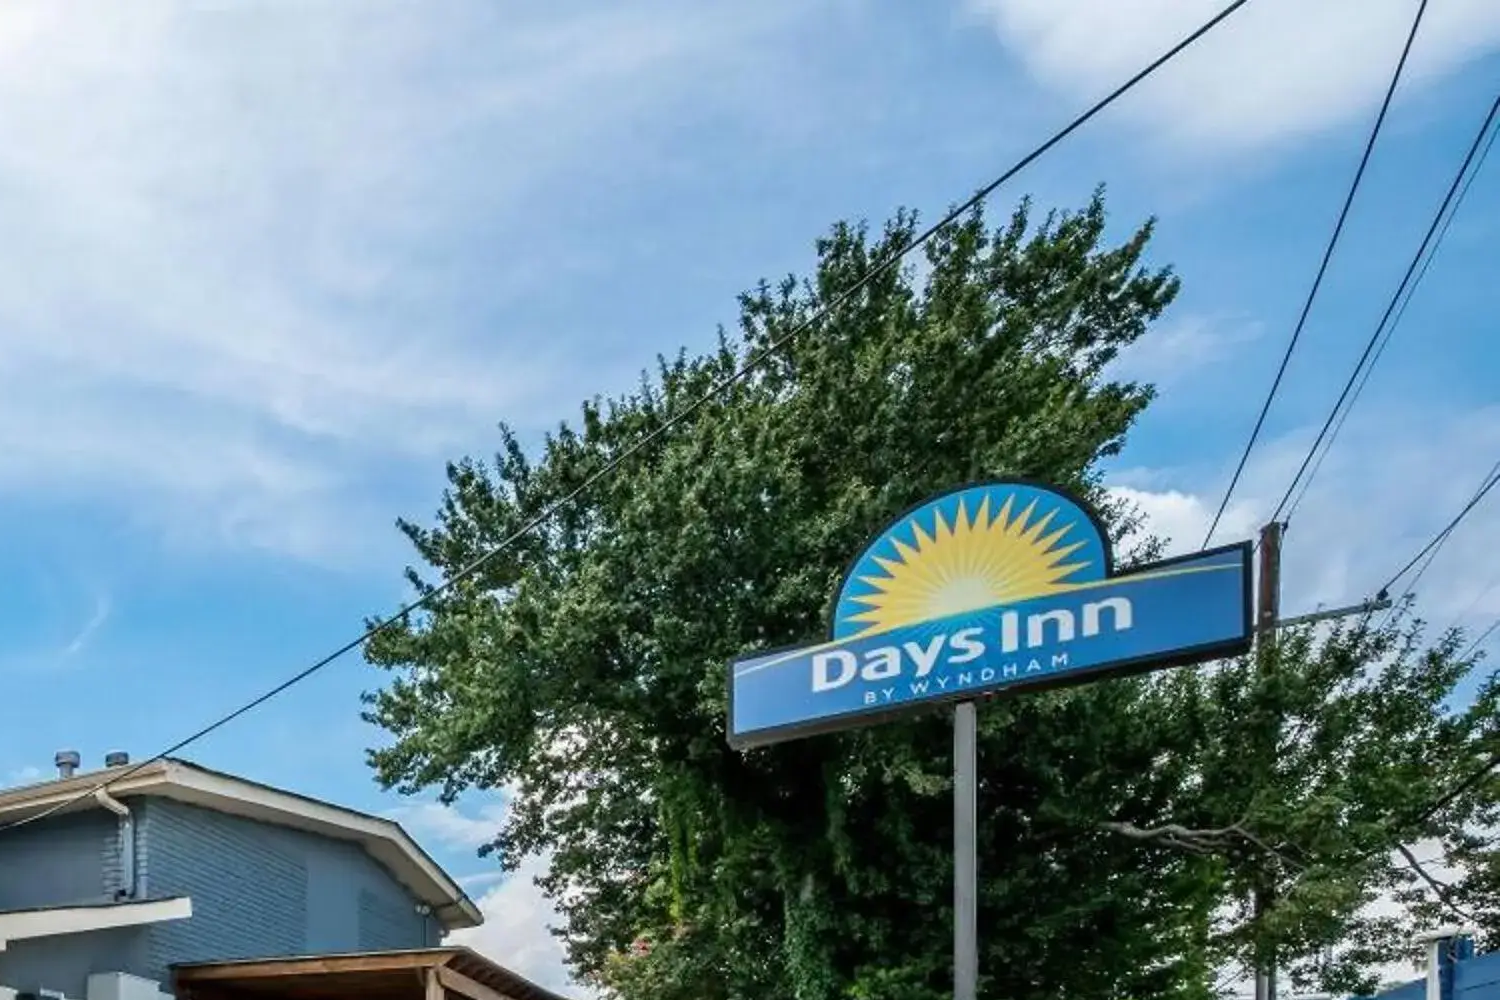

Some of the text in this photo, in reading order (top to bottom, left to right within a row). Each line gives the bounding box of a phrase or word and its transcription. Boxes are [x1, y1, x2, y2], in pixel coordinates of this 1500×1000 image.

[812, 597, 1132, 693] Days Inn
[865, 653, 1068, 704] BY WYNDHAM
